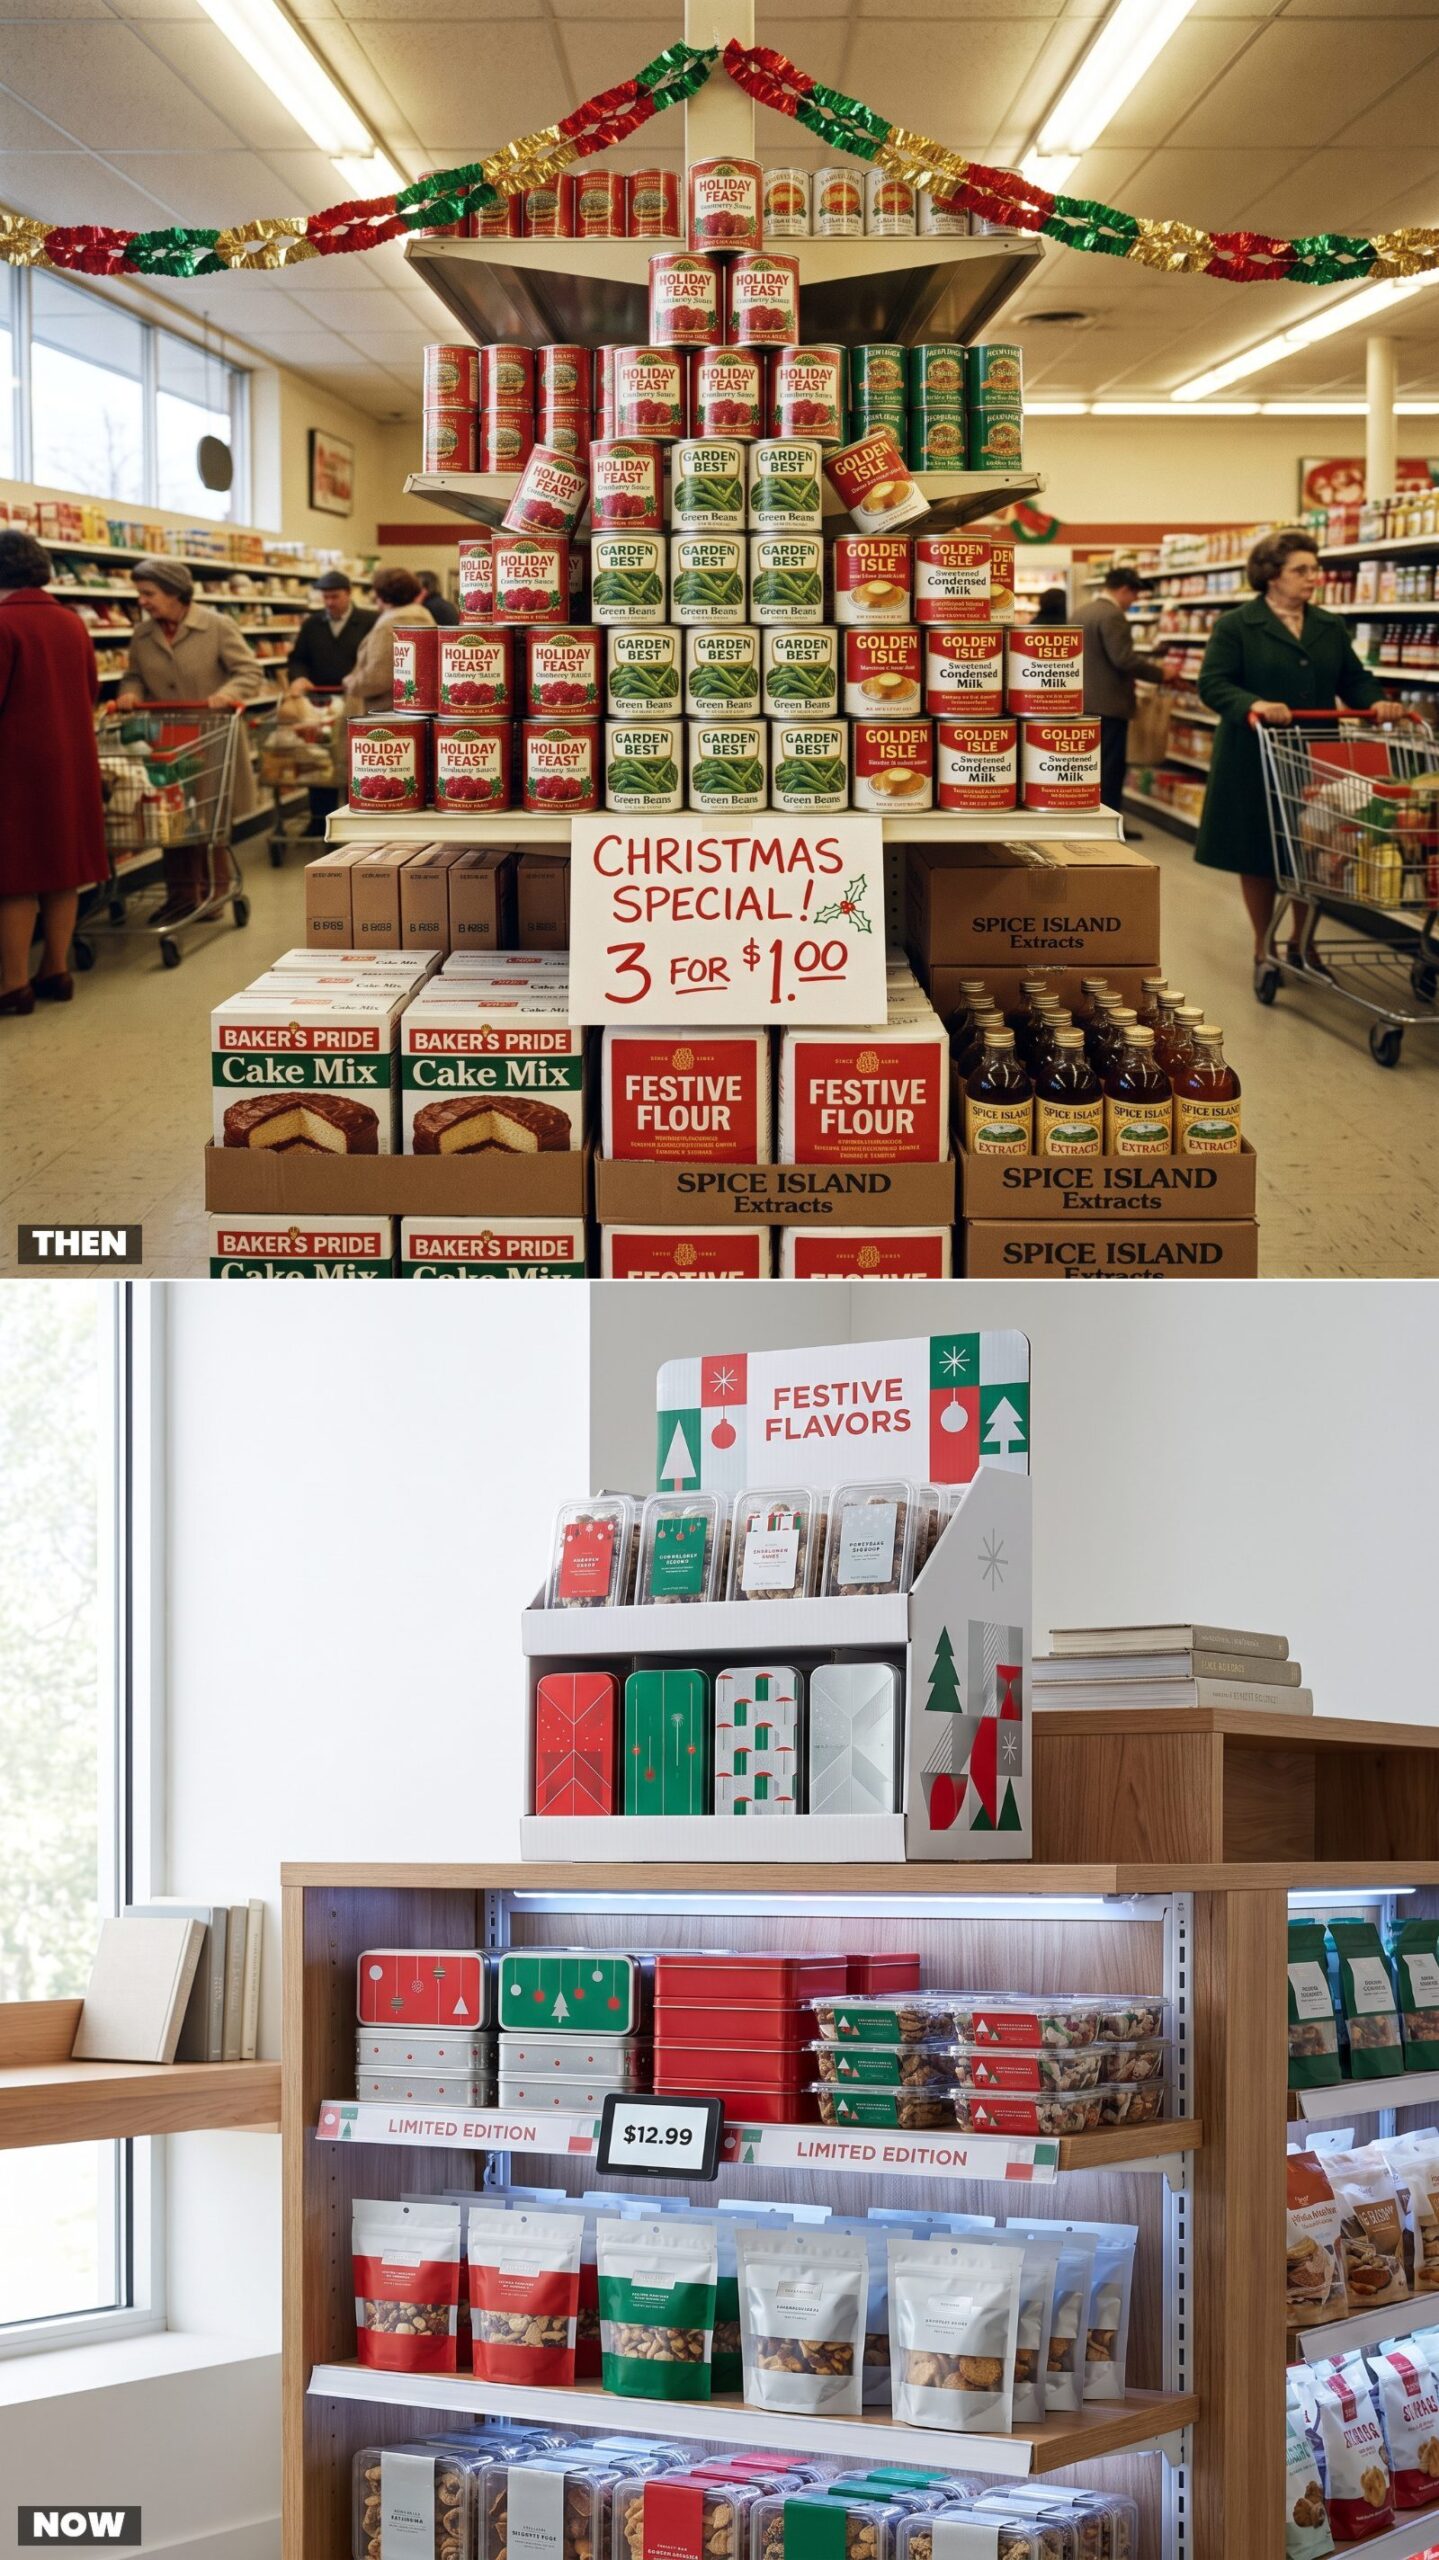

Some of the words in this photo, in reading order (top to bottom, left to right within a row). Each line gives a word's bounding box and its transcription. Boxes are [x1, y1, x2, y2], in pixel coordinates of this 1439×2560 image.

[699, 181, 752, 192] HOLIDAY
[705, 191, 746, 203] FEAST
[660, 273, 712, 286] HOLIDAY
[736, 273, 790, 286] HOLIDAY
[666, 285, 706, 297] FEAST
[743, 285, 783, 297] FEAST
[622, 368, 676, 381] HOLIDAY
[702, 368, 756, 381] HOLIDAY
[780, 368, 833, 381] HOLIDAY
[629, 379, 669, 391] FEAST
[709, 379, 749, 391] FEAST
[787, 379, 827, 391] FEAST
[683, 451, 736, 462] GARDEN
[760, 451, 813, 462] GARDEN
[834, 441, 892, 476] GOLDEN
[597, 461, 650, 473] HOLIDAY
[694, 462, 728, 473] BEST
[770, 462, 804, 473] BEST
[853, 458, 889, 482] ISLE
[533, 465, 586, 492] HOLIDAY
[603, 472, 643, 484] FEAST
[535, 478, 575, 500] FEAST
[681, 513, 710, 522] Green
[711, 513, 738, 522] Beans
[600, 546, 653, 556] GARDEN
[682, 546, 735, 556] GARDEN
[762, 546, 815, 556] GARDEN
[847, 544, 907, 558] GOLDEN
[930, 544, 983, 555] GOLDEN
[461, 560, 492, 571] HOLID
[500, 555, 555, 567] HOLIDAY
[610, 557, 644, 567] BEST
[692, 557, 726, 567] BEST
[772, 557, 806, 567] BEST
[860, 558, 896, 572] ISLE
[943, 556, 973, 566] ISLE
[506, 567, 547, 578] FEAST
[935, 570, 979, 578] Sweetened
[927, 576, 987, 587] Condensed
[945, 586, 971, 595] Milk
[599, 607, 626, 616] Green
[628, 607, 656, 616] Beans
[617, 639, 671, 650] GARDEN
[698, 639, 751, 650] GARDEN
[775, 639, 828, 650] GARDEN
[856, 635, 917, 649] GOLDEN
[942, 636, 996, 647] GOLDEN
[1024, 636, 1079, 647] GOLDEN
[444, 648, 500, 660] HOLIDAY
[535, 648, 591, 660] HOLIDAY
[627, 650, 662, 660] BEST
[708, 650, 742, 660] BEST
[786, 650, 820, 660] BEST
[870, 650, 907, 664] ISLE
[955, 648, 986, 659] ISLE
[1038, 648, 1069, 658] ISLE
[451, 661, 493, 672] FEAST
[542, 661, 584, 672] FEAST
[1031, 661, 1074, 669] Sweetened
[939, 669, 998, 679] Condensed
[1022, 669, 1080, 678] Condensed
[956, 679, 983, 689] Milk
[1040, 679, 1067, 688] Milk
[616, 700, 643, 709] Green
[645, 700, 673, 709] Beans
[615, 733, 668, 744] GARDEN
[702, 733, 756, 744] GARDEN
[785, 733, 839, 744] GARDEN
[866, 730, 928, 744] GOLDEN
[953, 730, 1009, 741] GOLDEN
[1041, 729, 1095, 740] GOLDEN
[354, 742, 411, 754] HOLIDAY
[440, 742, 497, 754] HOLIDAY
[530, 742, 587, 754] HOLIDAY
[624, 745, 659, 755] BEST
[712, 745, 747, 755] BEST
[795, 745, 830, 755] BEST
[880, 745, 917, 758] ISLE
[967, 741, 998, 752] ISLE
[1055, 741, 1086, 752] ISLE
[361, 755, 403, 766] FEAST
[447, 755, 489, 766] FEAST
[538, 755, 580, 766] FEAST
[960, 756, 1005, 764] Sweetened
[951, 762, 1012, 773] Condensed
[1039, 762, 1098, 772] Condensed
[968, 772, 996, 783] Milk
[1057, 772, 1084, 782] Milk
[614, 795, 641, 804] Green
[643, 795, 671, 804] Beans
[593, 834, 843, 877] CHRISTMAS
[613, 879, 814, 923] SPECIAL!
[972, 917, 1036, 933] SPICE
[1043, 917, 1122, 932] ISLAND
[1010, 934, 1085, 950] Extracts
[604, 942, 652, 1004] 3
[670, 956, 731, 985] FOR
[742, 937, 848, 1004] $1.00
[224, 1029, 307, 1049] BAKER'S
[313, 1030, 374, 1048] PRIDE
[414, 1032, 500, 1051] BAKER'S
[505, 1033, 567, 1050] PRIDE
[221, 1056, 305, 1084] Cake
[313, 1058, 378, 1084] Mix
[412, 1060, 497, 1087] Cake
[505, 1060, 570, 1086] Mix
[625, 1075, 742, 1102] FESTIVE
[809, 1079, 927, 1105] FESTIVE
[972, 1106, 998, 1119] SPICE
[1043, 1106, 1071, 1119] SPICE
[1114, 1105, 1142, 1118] SPICE
[1181, 1103, 1210, 1117] SPICE
[637, 1105, 731, 1131] FLOUR
[820, 1109, 914, 1134] FLOUR
[978, 1142, 1027, 1154] EXTRACTS
[1050, 1142, 1099, 1154] EXTRACTS
[1121, 1140, 1170, 1153] EXTRACTS
[1189, 1139, 1238, 1151] EXTRACTS
[676, 1173, 768, 1194] SPICE
[777, 1173, 892, 1193] ISLAND
[1002, 1167, 1094, 1189] SPICE
[1104, 1167, 1218, 1189] ISLAND
[733, 1196, 833, 1214] Extracts
[1062, 1191, 1162, 1210] Extracts
[223, 1234, 307, 1253] BAKER'S
[313, 1236, 376, 1254] PRIDE
[415, 1239, 500, 1257] BAKER'S
[506, 1239, 569, 1257] PRIDE
[1003, 1243, 1097, 1264] SPICE
[1106, 1243, 1223, 1264] ISLAND
[774, 1378, 903, 1411] FESTIVE
[765, 1408, 911, 1442] FLAVORS
[388, 2118, 458, 2137] LIMITED
[463, 2123, 537, 2142] EDITION
[623, 2124, 693, 2146] $12.99
[797, 2141, 876, 2161] LIMITED
[882, 2146, 968, 2167] EDITION
